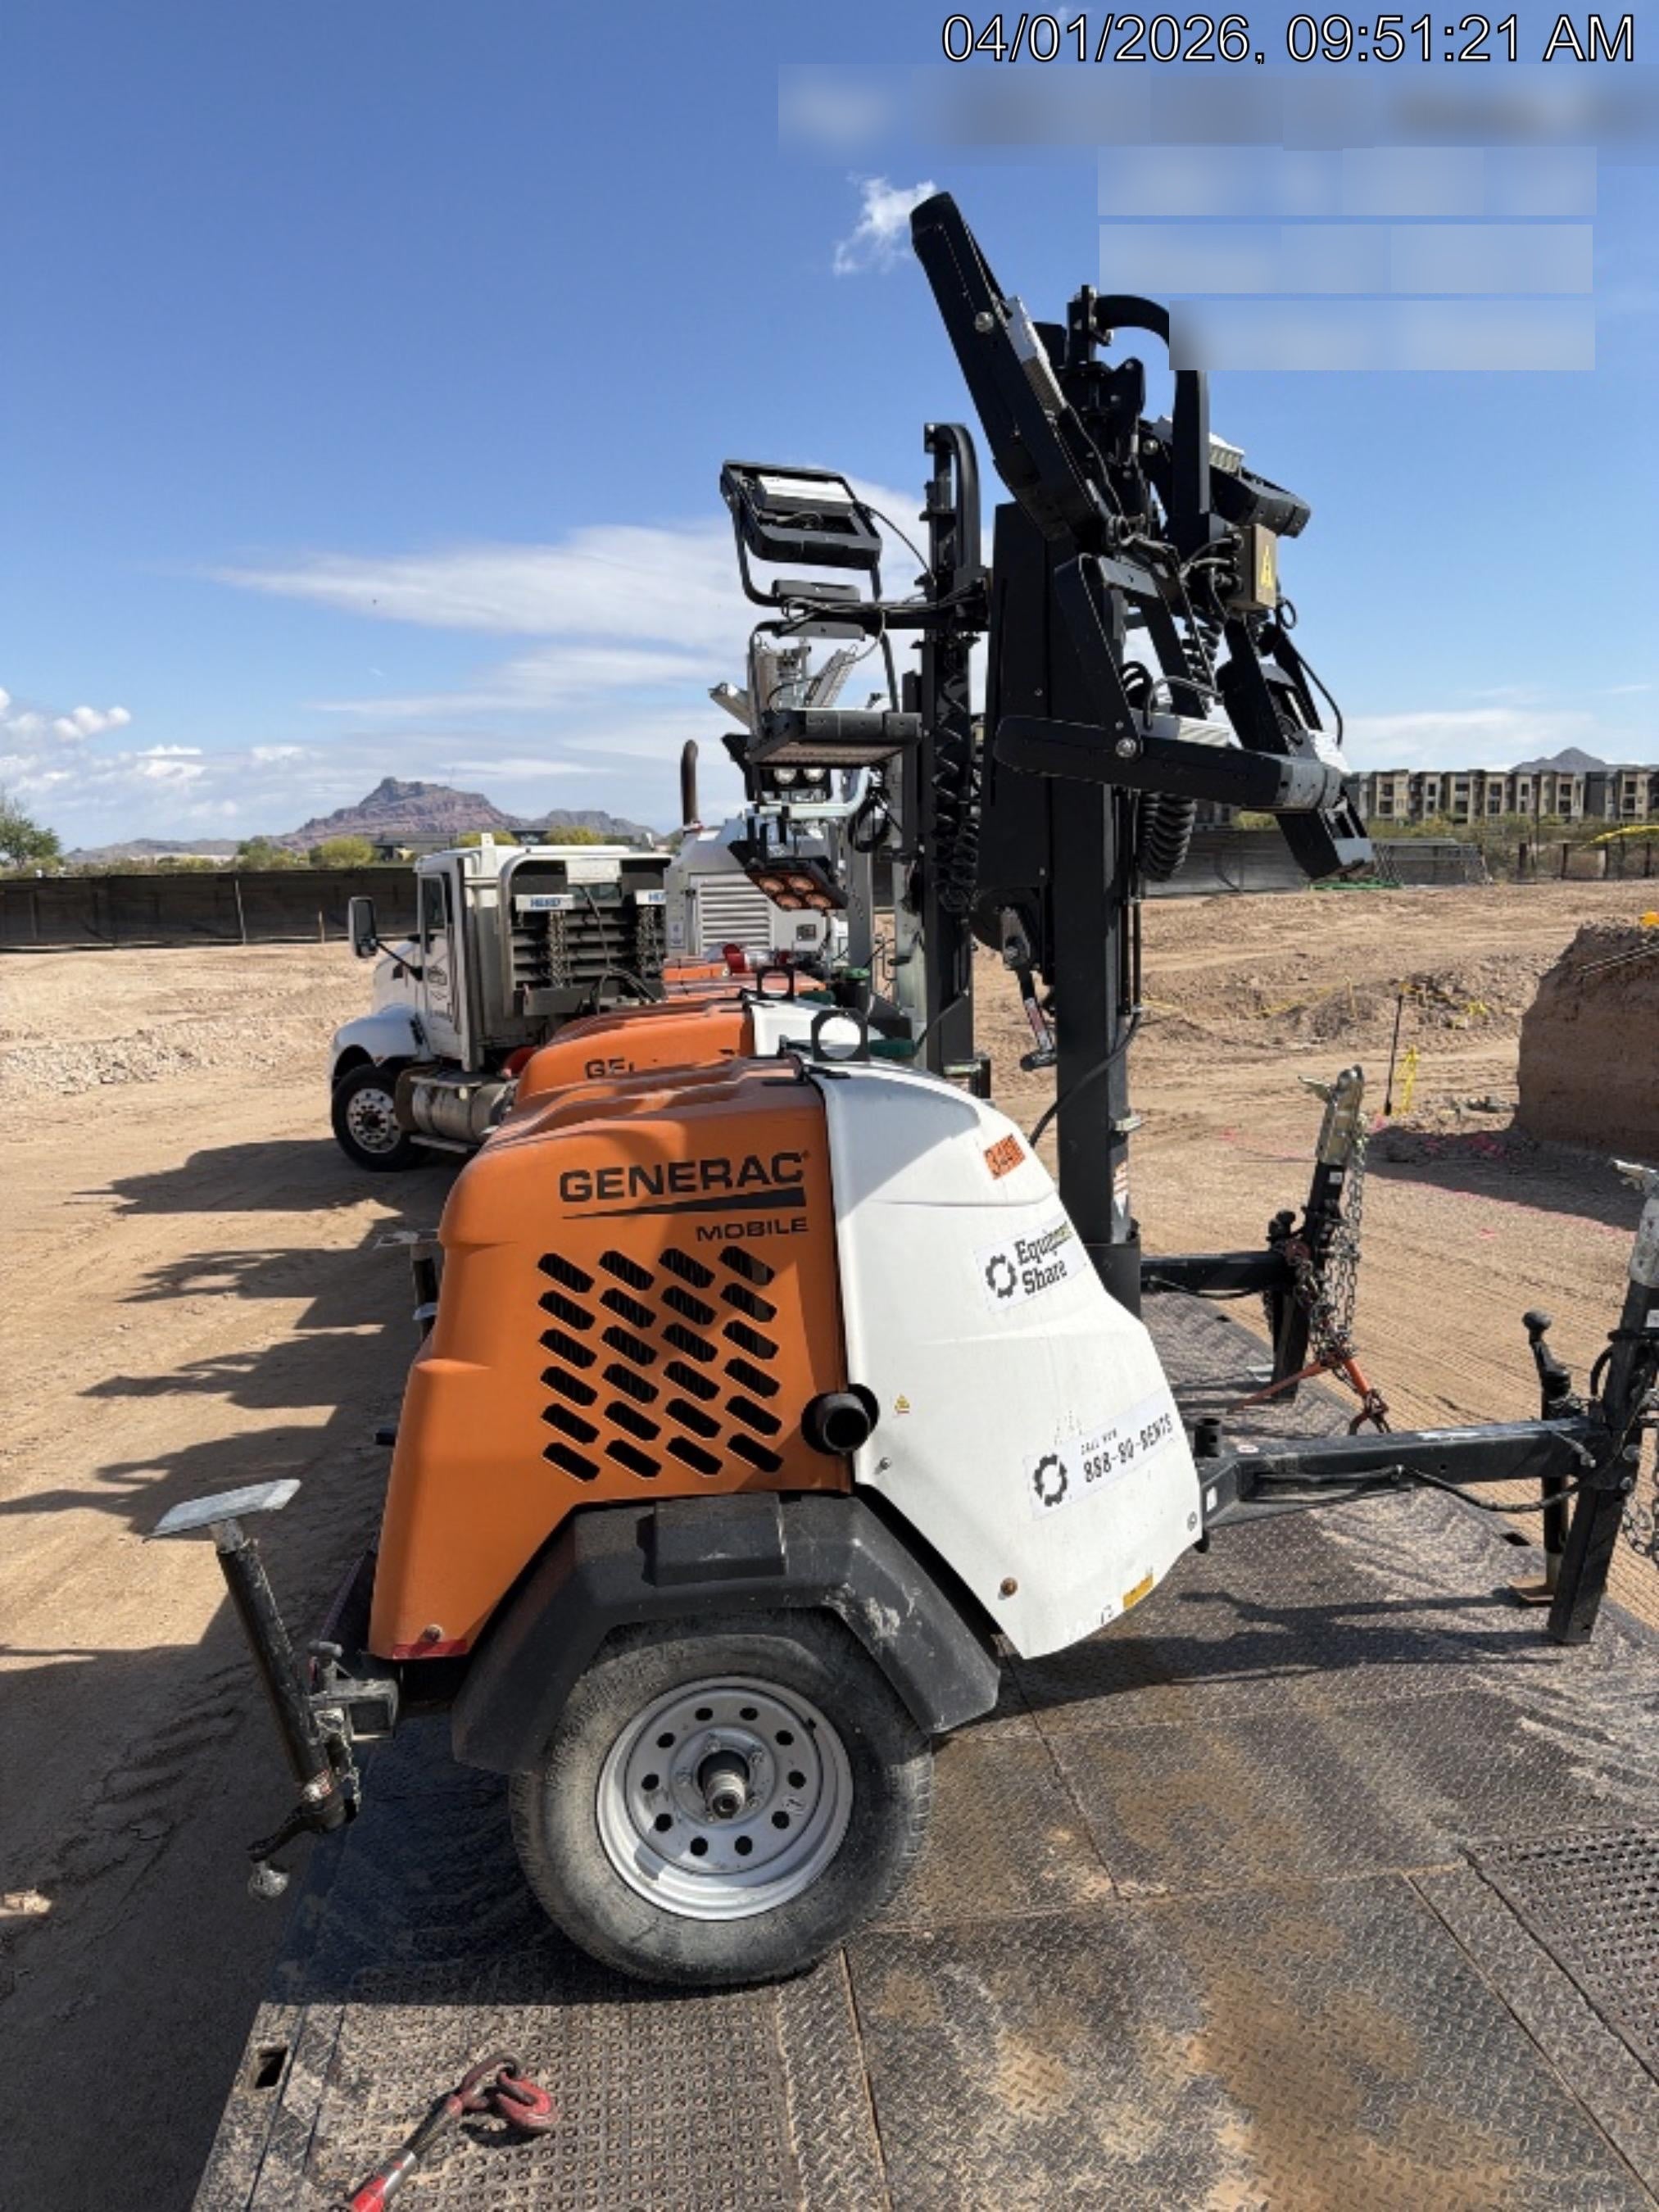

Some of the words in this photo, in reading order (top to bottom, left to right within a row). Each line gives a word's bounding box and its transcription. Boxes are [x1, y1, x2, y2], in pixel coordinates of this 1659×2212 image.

[560, 1152, 805, 1202] GENERAC
[696, 1217, 809, 1242] MOBILE
[1022, 1260, 1068, 1295] Share
